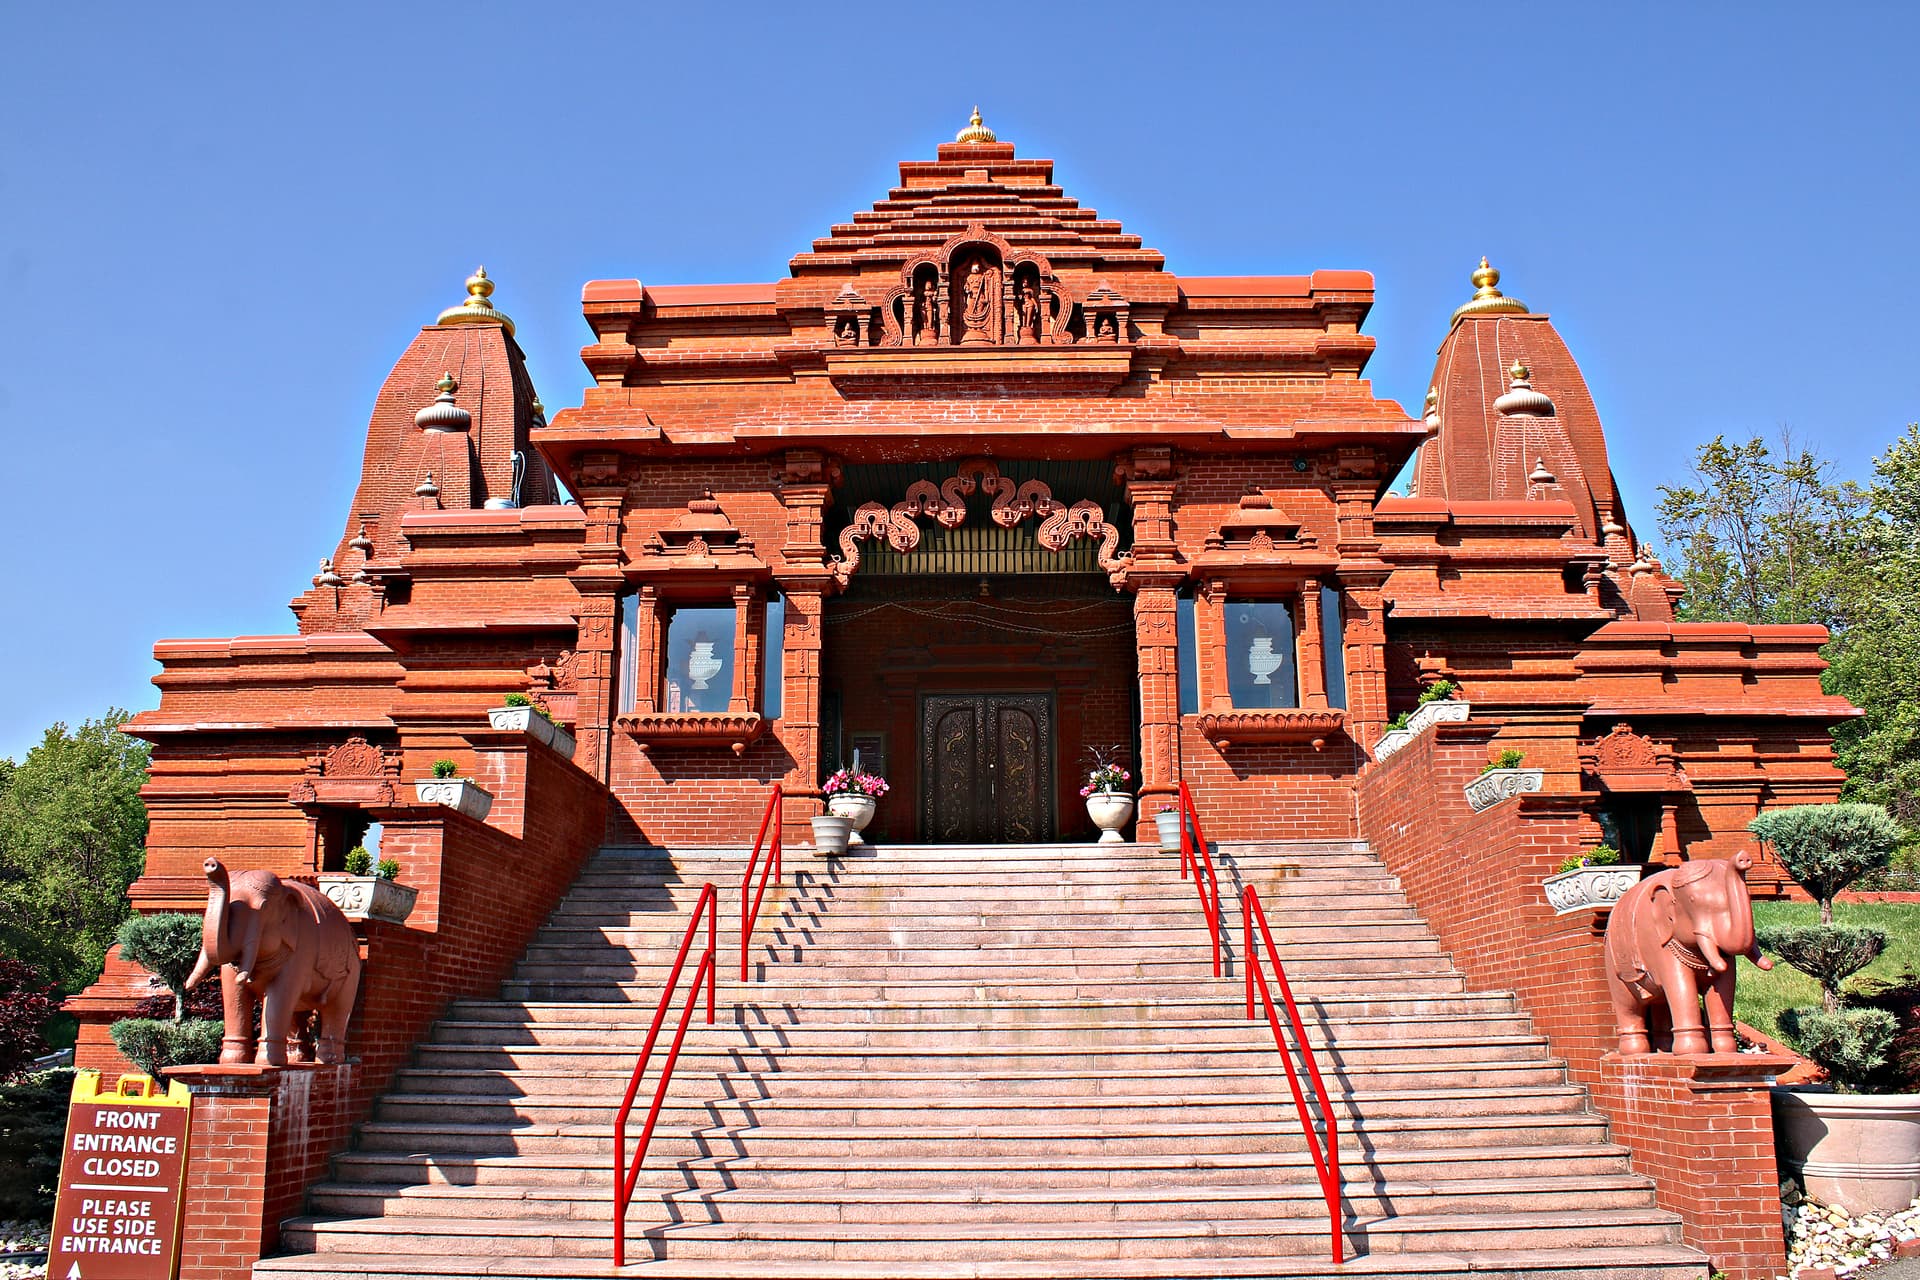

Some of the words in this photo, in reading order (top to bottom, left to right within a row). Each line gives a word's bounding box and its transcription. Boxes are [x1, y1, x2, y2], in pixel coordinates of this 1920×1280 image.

[94, 1110, 161, 1130] FRONT
[73, 1133, 177, 1154] ENTRANCE
[83, 1158, 160, 1177] CLOSED
[81, 1199, 152, 1217] PLEASE
[72, 1218, 109, 1234] USE
[112, 1219, 157, 1236] SIDE
[61, 1236, 162, 1255] ENTRANCE
